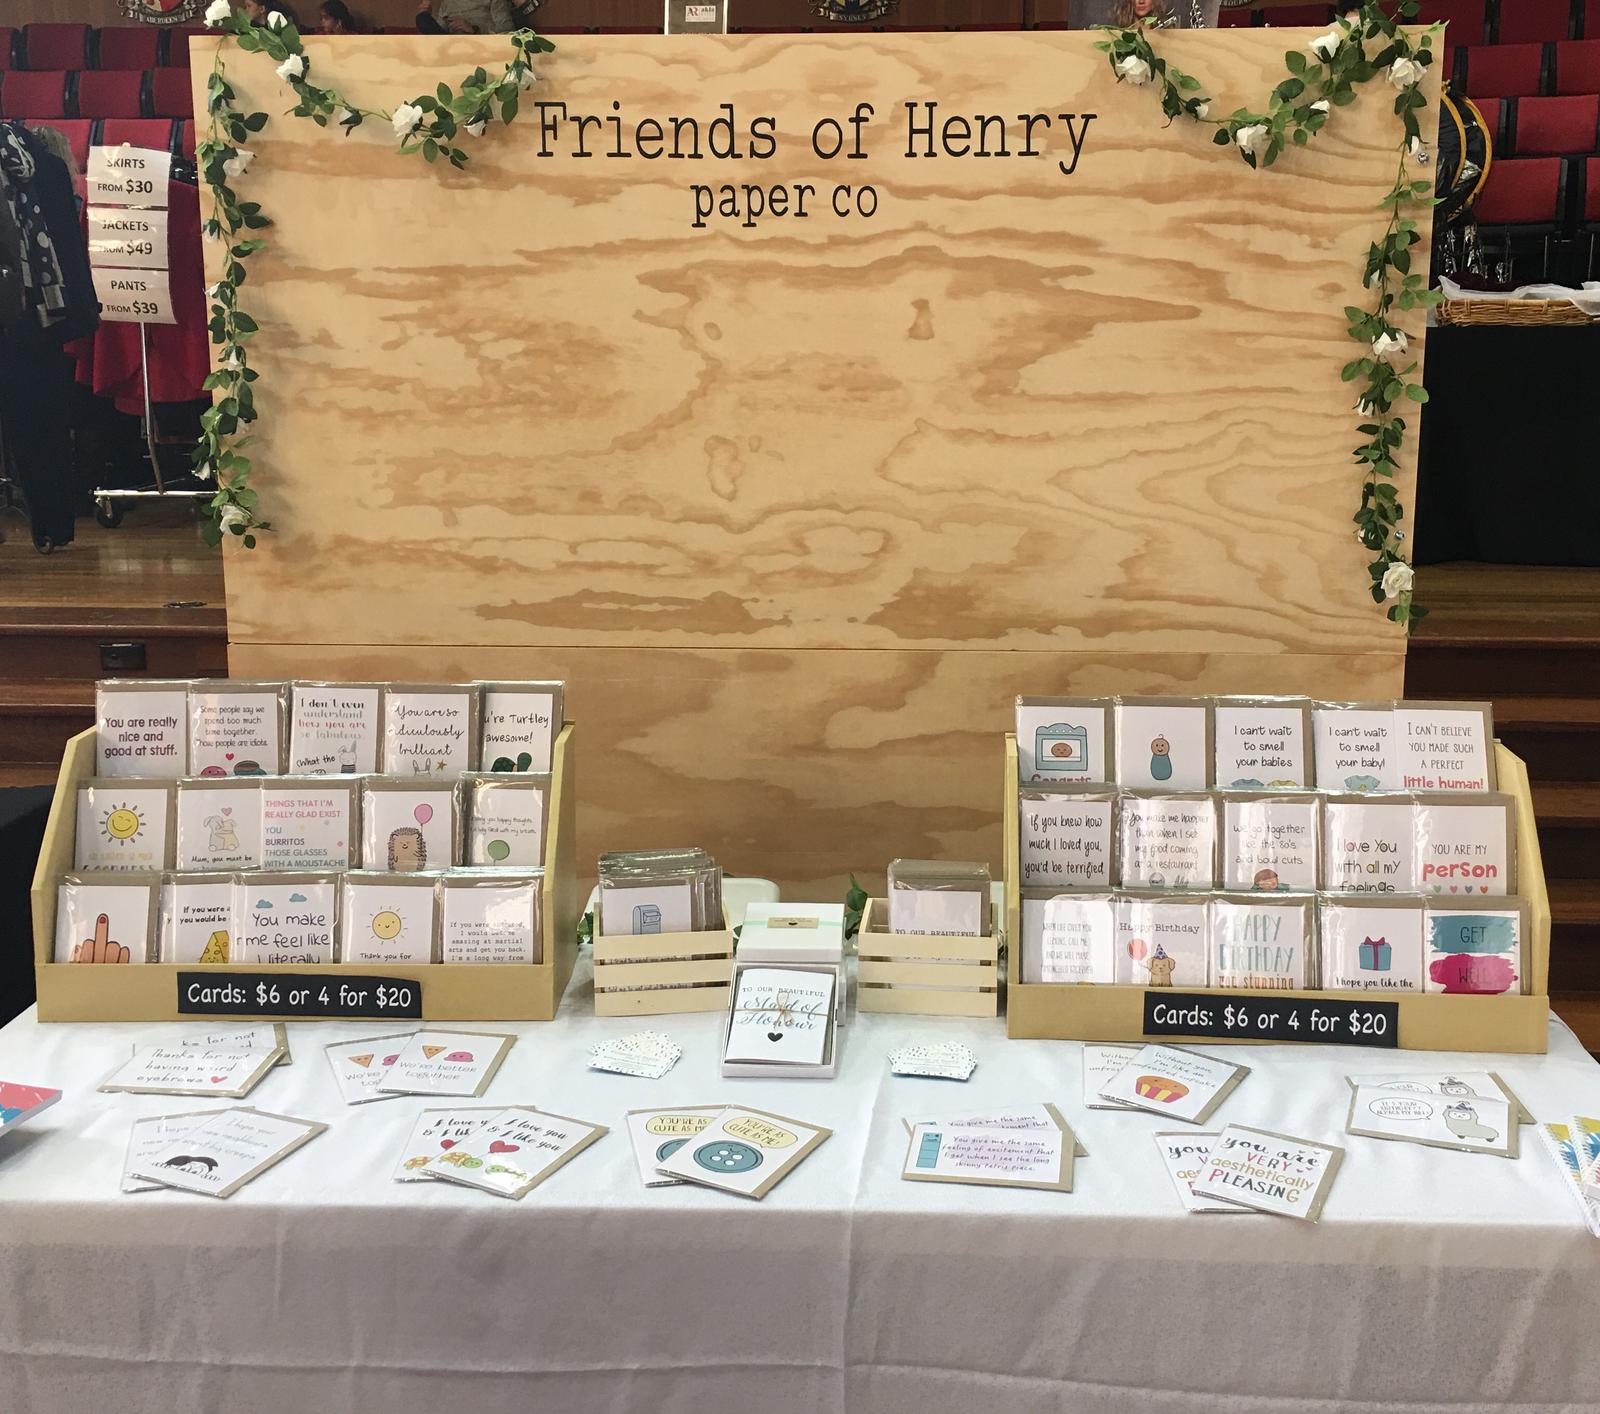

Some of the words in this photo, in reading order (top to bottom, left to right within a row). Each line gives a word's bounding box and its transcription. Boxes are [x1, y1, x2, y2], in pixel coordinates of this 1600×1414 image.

[533, 101, 777, 160] Friends
[812, 102, 875, 160] of
[904, 101, 1098, 175] Henry
[107, 159, 145, 169] SKIRTS
[97, 183, 123, 192] FROM
[126, 179, 152, 194] $30
[690, 183, 816, 228] paper
[831, 183, 878, 218] co
[102, 220, 149, 231] JACKETS
[102, 245, 124, 254] ROM
[126, 242, 152, 256] $49
[111, 280, 147, 291] PANTS
[107, 304, 131, 313] FROM
[132, 300, 158, 316] $39
[219, 705, 240, 715] people
[395, 705, 423, 719] You
[105, 717, 124, 728] You
[128, 719, 145, 727] are
[149, 717, 178, 728] really
[243, 716, 261, 724] much
[509, 713, 549, 728] Turtley
[1234, 725, 1237, 736] I
[1240, 726, 1265, 736] can't
[1268, 726, 1292, 736] wait
[1329, 727, 1332, 736] I
[1334, 727, 1360, 737] can't
[1363, 727, 1387, 738] wait
[1408, 722, 1411, 735] I
[1415, 723, 1437, 736] CAN'T
[1441, 727, 1472, 737] BELIEVE
[119, 731, 140, 742] nice
[143, 731, 163, 741] and
[486, 732, 533, 744] awesome!
[105, 745, 132, 758] good
[135, 746, 146, 756] at
[150, 744, 178, 756] stuff.
[399, 743, 452, 756] brilliant
[1244, 741, 1256, 751] to
[1259, 741, 1285, 751] smell
[1339, 742, 1351, 751] to
[1354, 742, 1380, 752] smell
[1409, 743, 1425, 752] YOU
[1429, 743, 1450, 752] MADE
[1453, 743, 1474, 753] SUCH
[1236, 758, 1258, 768] your
[1261, 756, 1293, 767] babies
[1335, 758, 1358, 769] your
[1361, 757, 1385, 770] baby!
[1420, 760, 1427, 769] A
[1431, 760, 1464, 770] PERFECT
[1404, 775, 1434, 788] little
[1439, 776, 1483, 789] human!
[265, 800, 295, 808] THINGS
[320, 799, 333, 807] I'M
[319, 810, 341, 818] EXIST
[1030, 815, 1039, 831] If
[1041, 817, 1058, 829] you
[1060, 815, 1083, 827] knew
[1085, 815, 1103, 827] how
[1267, 824, 1305, 839] together
[1028, 839, 1051, 850] much
[1054, 839, 1056, 850] I
[1060, 838, 1081, 851] loved
[1344, 839, 1370, 852] love
[1375, 839, 1397, 853] You
[1432, 844, 1450, 855] YOU
[1454, 844, 1471, 855] ARE
[1475, 845, 1487, 855] MY
[265, 849, 291, 857] THOSE
[264, 860, 285, 868] WITH
[295, 859, 345, 867] MOUSTACHE
[1281, 856, 1304, 864] cuts
[1367, 860, 1379, 873] all
[1024, 862, 1048, 878] you'd
[1052, 861, 1063, 872] be
[1423, 862, 1497, 881] person
[195, 915, 215, 923] would
[252, 913, 279, 927] You
[286, 913, 327, 927] make
[1155, 923, 1200, 934] Birthday
[1460, 926, 1487, 943] GET
[245, 934, 270, 945] me
[272, 933, 302, 948] feel
[308, 933, 330, 945] like
[384, 954, 397, 962] you
[399, 952, 412, 960] for
[1341, 977, 1361, 989] hope
[1363, 980, 1378, 990] you
[1380, 977, 1398, 987] like
[1400, 978, 1414, 988] the
[187, 982, 247, 1004] Cards:
[256, 981, 281, 1006] $6
[288, 991, 310, 1006] or
[317, 986, 330, 1006] 4
[339, 984, 368, 1007] for
[376, 983, 412, 1009] $20
[778, 987, 825, 997] BEAUTIFUL
[744, 997, 799, 1010] Mad
[1153, 1003, 1213, 1026] Cards:
[1223, 1003, 1249, 1029] $6
[1257, 1013, 1280, 1029] or
[1287, 1010, 1300, 1030] 4
[1310, 1009, 1340, 1032] for
[1349, 1009, 1387, 1036] $20
[518, 1120, 542, 1133] love
[543, 1130, 568, 1140] you
[513, 1131, 537, 1144] like
[539, 1140, 561, 1152] you
[1220, 1137, 1270, 1154] you
[1277, 1151, 1320, 1168] are
[1247, 1152, 1292, 1172] VERY
[1211, 1157, 1315, 1192] aesthetically
[1209, 1168, 1300, 1202] PLEASING
